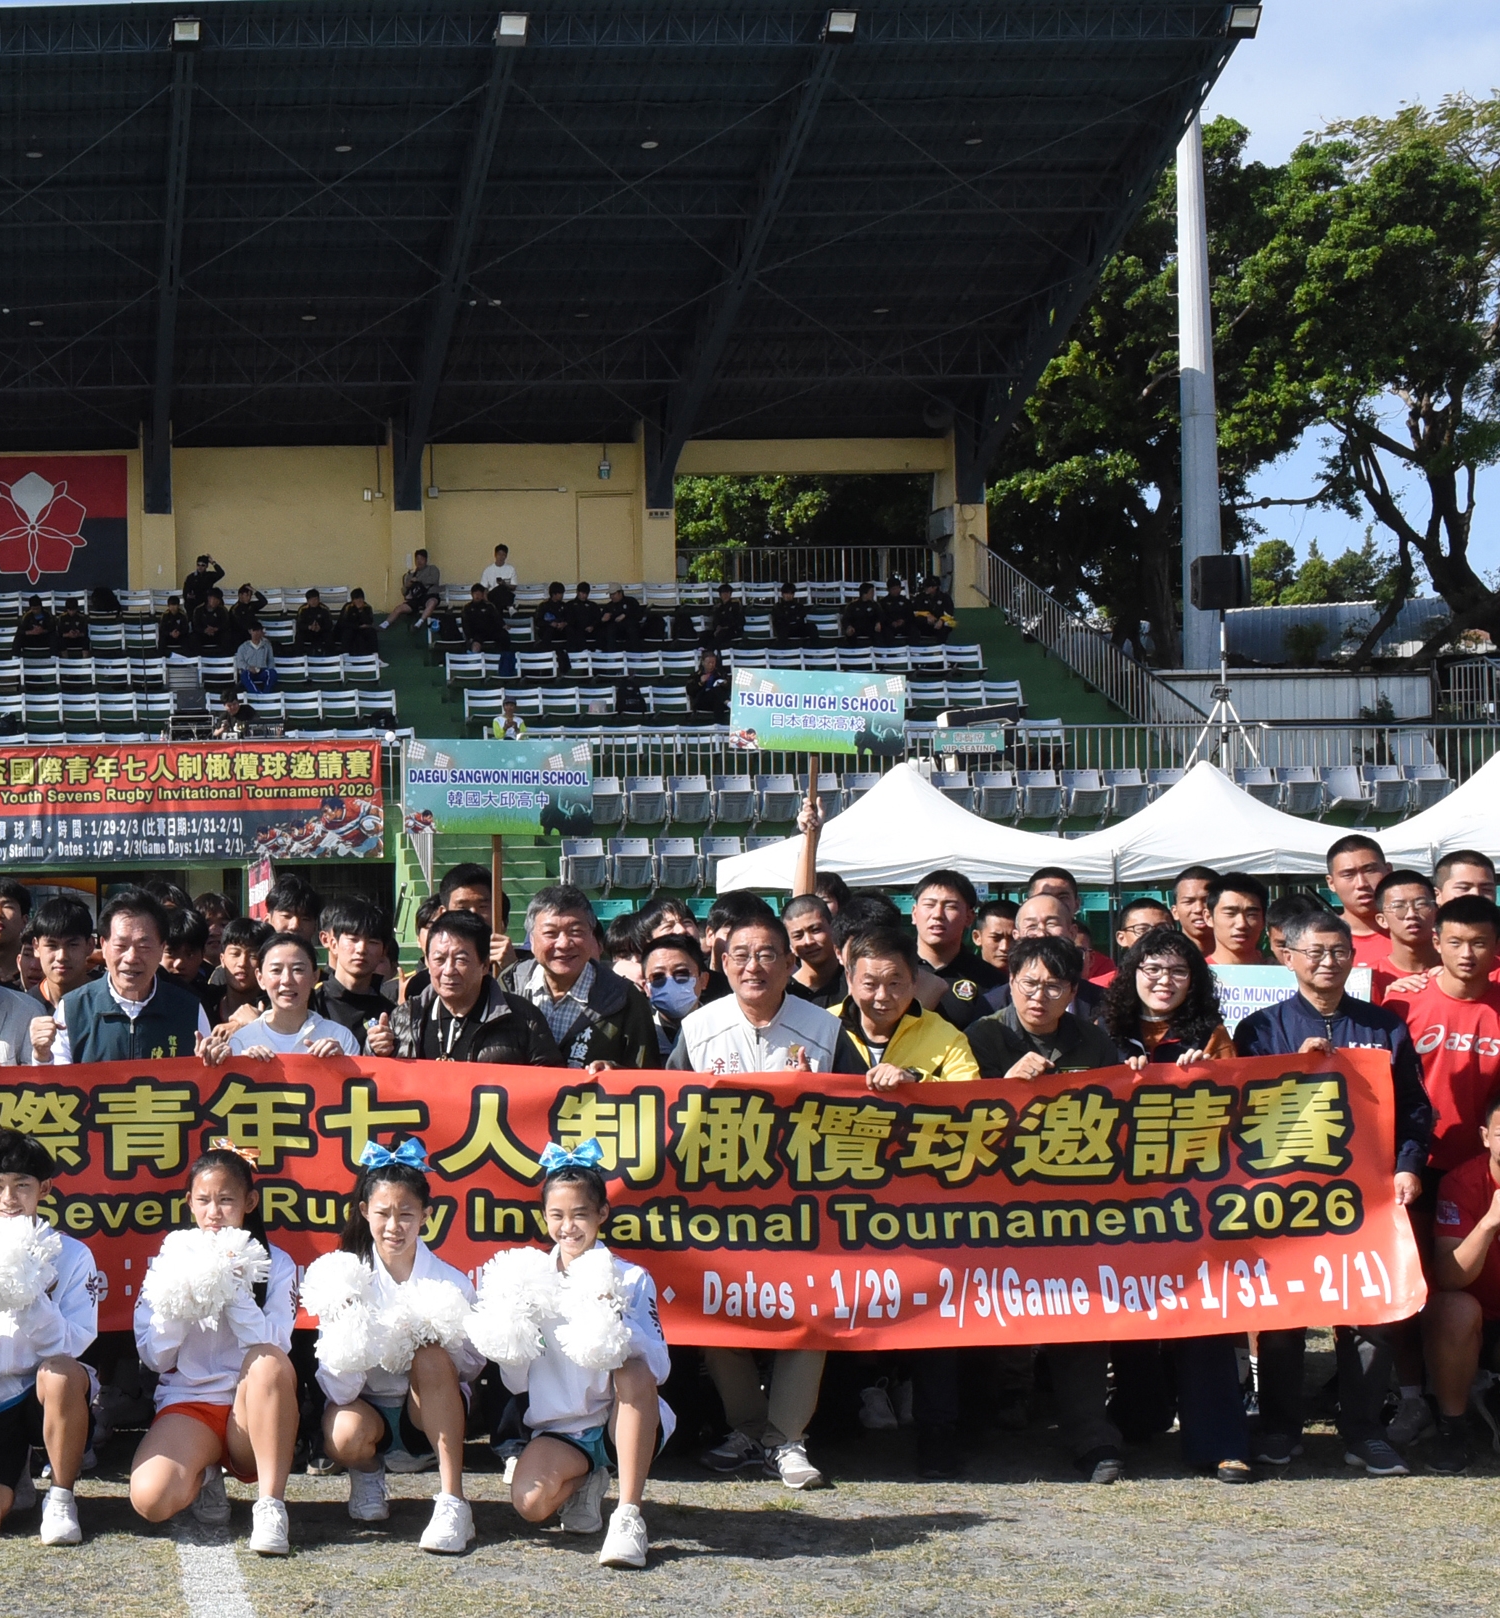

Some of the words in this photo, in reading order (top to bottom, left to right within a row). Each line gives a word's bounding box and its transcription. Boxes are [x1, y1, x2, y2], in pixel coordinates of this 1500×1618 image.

[739, 692, 799, 709] TSURUGI
[802, 693, 837, 710] HIGH
[842, 695, 898, 713] SCHOOL
[771, 713, 866, 732] 日本鶴來高校
[942, 744, 957, 753] VIP
[959, 744, 996, 753] SEATING
[409, 769, 448, 784] DAEGU
[450, 769, 509, 785] SANGWON
[511, 770, 540, 785] HIGH
[542, 771, 589, 786] SCHOOL
[0, 789, 42, 804] Youth
[47, 788, 101, 803] Sevens
[106, 788, 153, 803] Rugby
[158, 785, 241, 799] Invitational
[246, 784, 334, 798] Tournament
[338, 783, 373, 797] 2026
[447, 791, 550, 809] 韓國大邱高中
[9, 844, 44, 858] Stadium
[58, 842, 83, 857] Dates
[93, 840, 114, 858] 1/29
[168, 839, 192, 856] Days:
[194, 838, 215, 856] 1/31
[1243, 988, 1298, 1003] MUNICIP
[36, 1192, 197, 1231] Seven
[474, 1196, 811, 1244] Invational
[834, 1197, 1193, 1243] Tournament
[1214, 1187, 1356, 1232] 2026
[702, 1270, 796, 1319] Dates
[830, 1268, 901, 1330] 1/29
[938, 1266, 1091, 1328] 2/3(Game
[1098, 1264, 1189, 1321] Days:
[1197, 1256, 1280, 1318] 1/31
[1313, 1250, 1393, 1311] 2/1)
